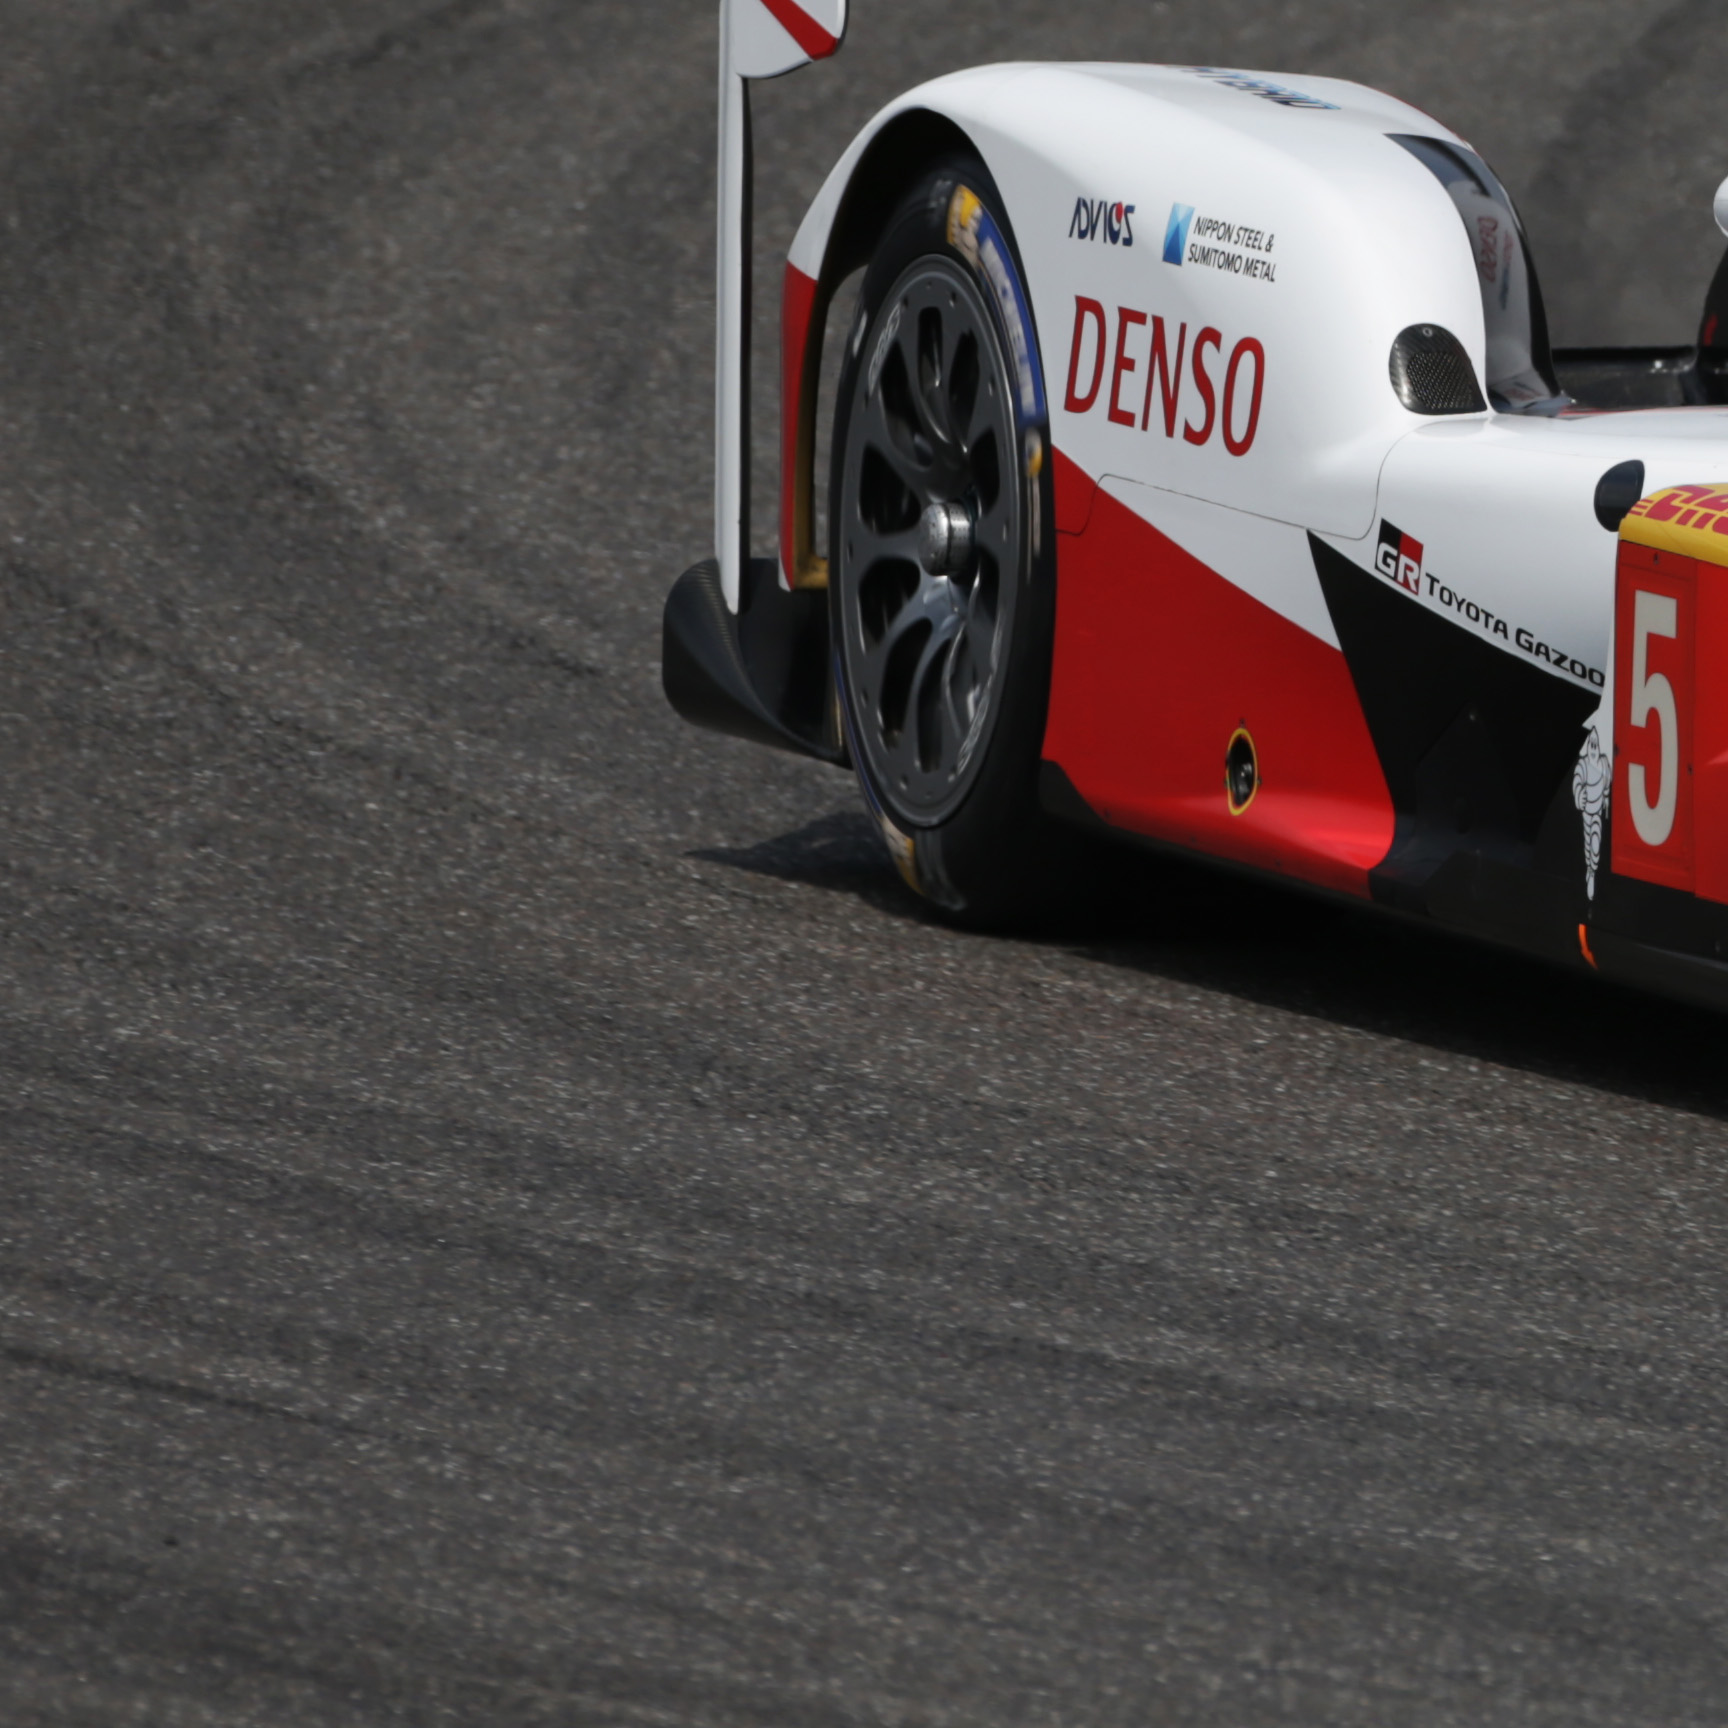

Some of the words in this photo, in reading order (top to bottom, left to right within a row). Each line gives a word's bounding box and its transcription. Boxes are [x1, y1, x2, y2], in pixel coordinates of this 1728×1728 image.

[1188, 243, 1243, 274] SUMITOMO
[1243, 258, 1277, 283] METAL
[1193, 216, 1234, 243] NIPPON
[1233, 226, 1264, 251] STEEL
[1265, 234, 1275, 253] &
[1064, 294, 1265, 457] DENSO
[1376, 541, 1420, 594] GR
[1425, 572, 1509, 640] TOYOTA
[1628, 589, 1678, 846] 5
